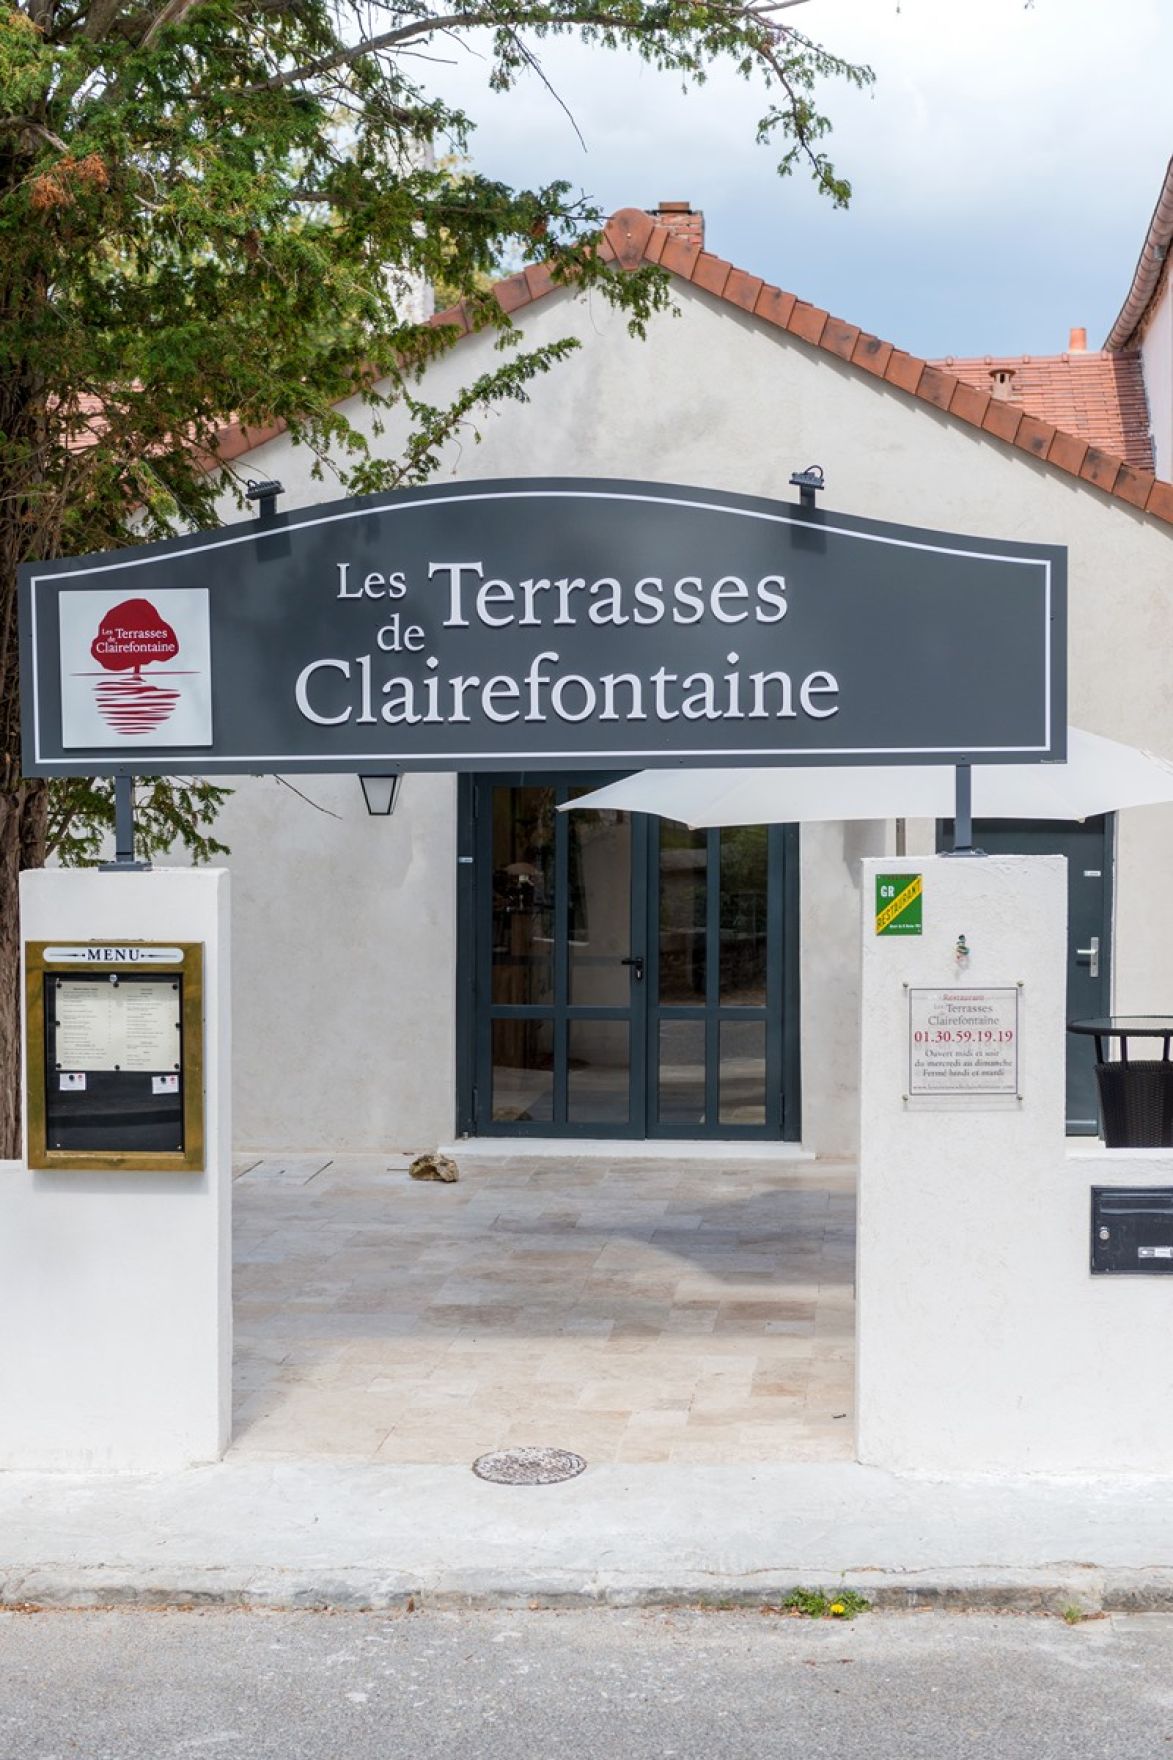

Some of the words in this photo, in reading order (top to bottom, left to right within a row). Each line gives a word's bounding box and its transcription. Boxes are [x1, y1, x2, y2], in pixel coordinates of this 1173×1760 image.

[336, 562, 407, 599] Les
[428, 560, 788, 628] Terrasses
[114, 628, 168, 639] Terrasses
[377, 612, 426, 652] de
[96, 640, 175, 654] Clairefontaine
[295, 651, 840, 725] Clairefontaine
[880, 885, 895, 897] GR
[87, 949, 140, 961] MENU
[946, 1003, 993, 1013] Terrasses
[927, 1015, 1000, 1026] Clairefontaine
[914, 1030, 1013, 1042] 01.30.59.19.19
